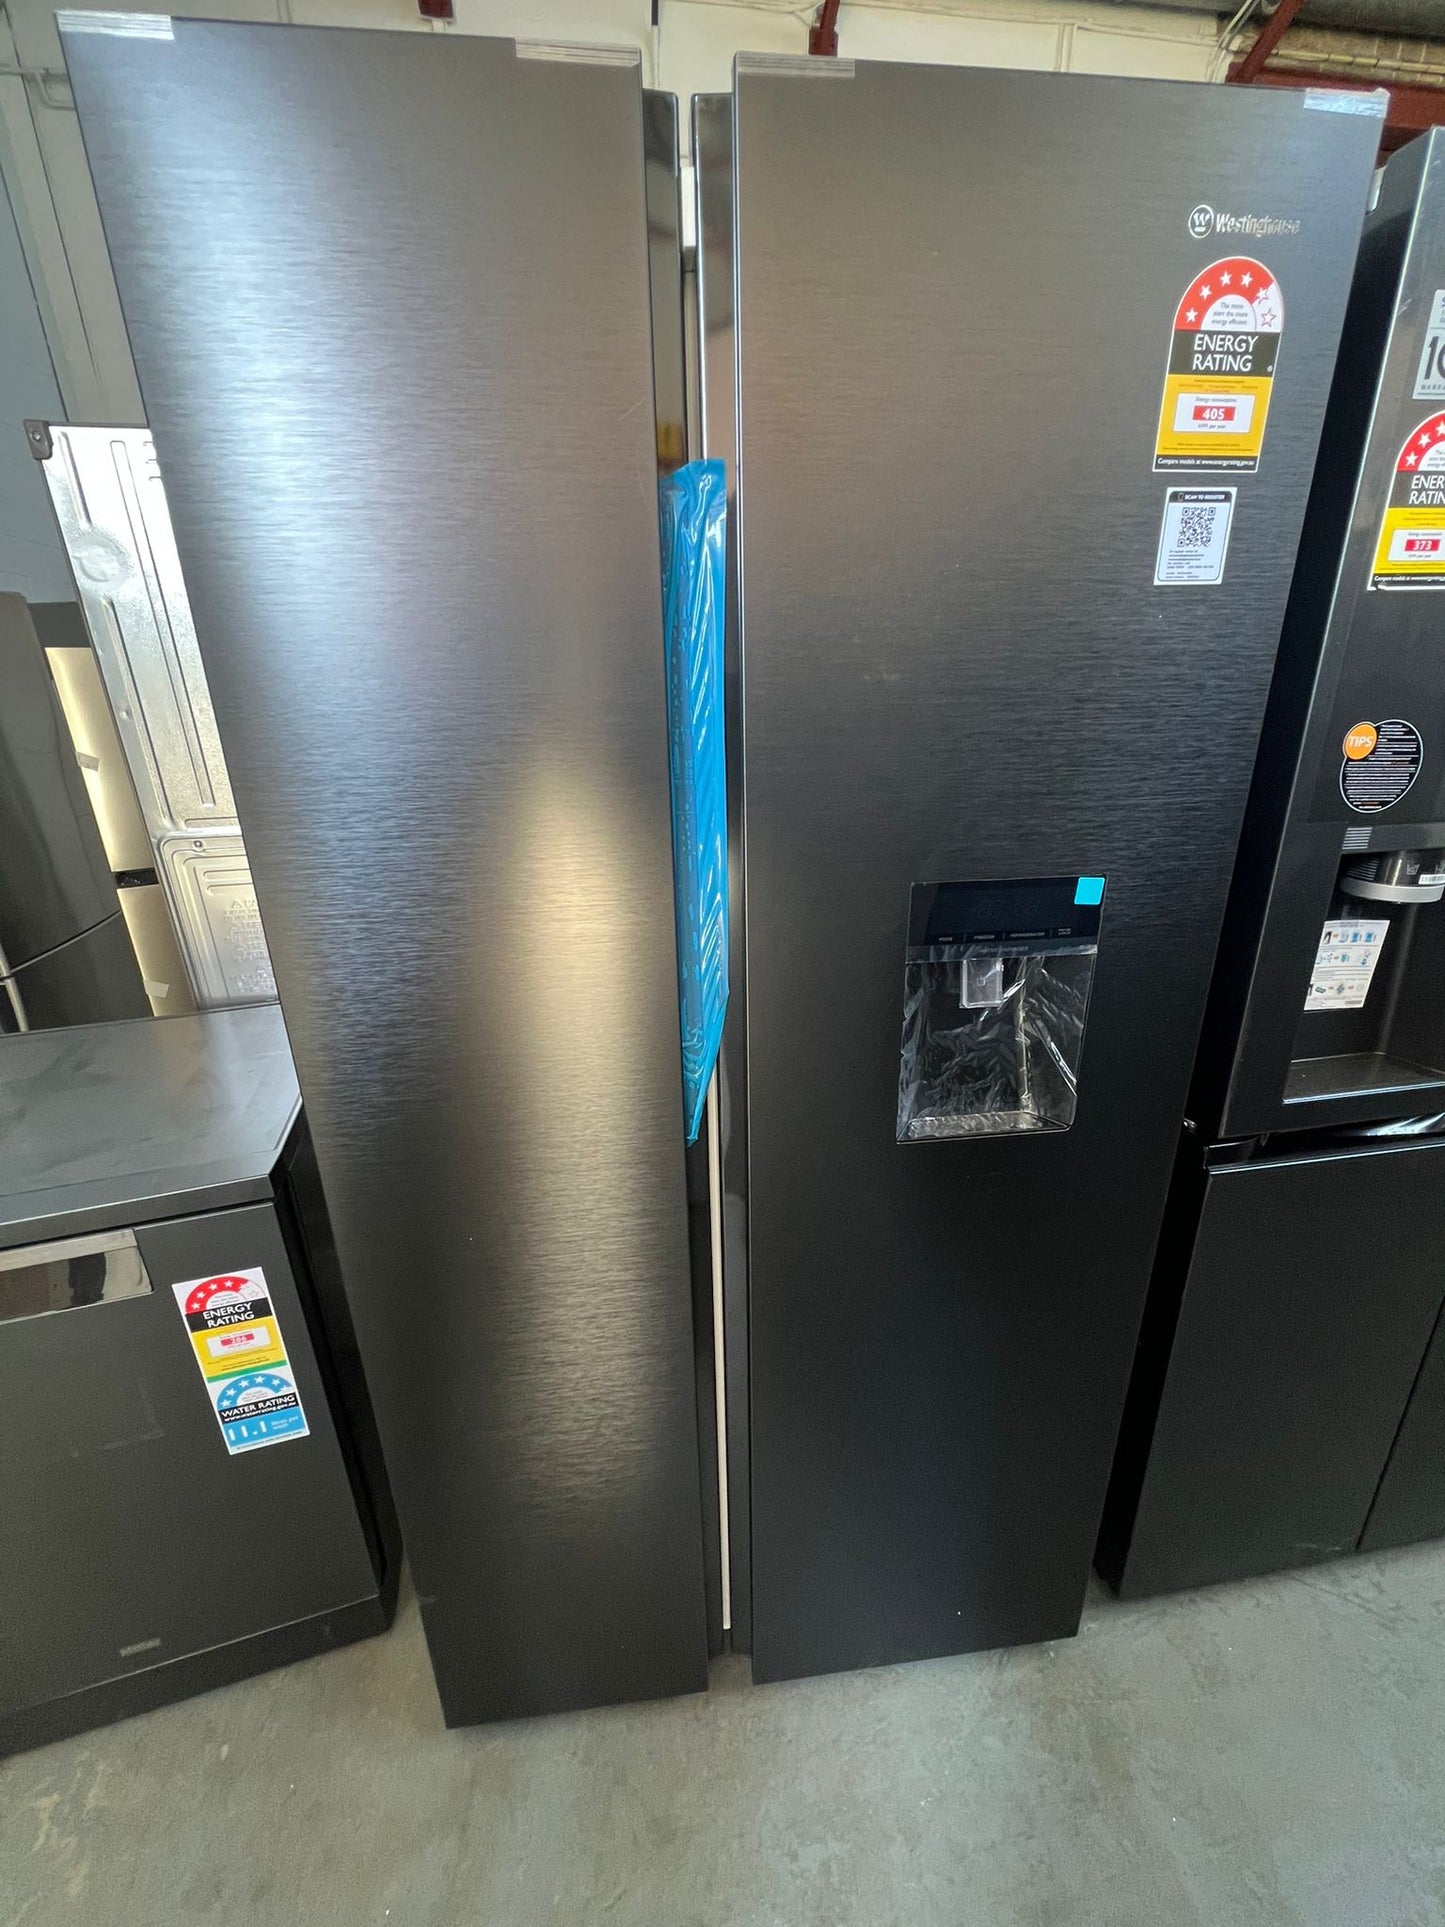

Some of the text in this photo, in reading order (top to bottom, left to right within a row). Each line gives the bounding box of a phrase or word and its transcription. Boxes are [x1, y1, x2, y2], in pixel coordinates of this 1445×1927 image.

[1215, 213, 1300, 237] Westinghouse
[1194, 333, 1258, 353] ENERGY
[1192, 353, 1253, 372] RATING
[1202, 407, 1226, 420] 405
[1413, 540, 1432, 551] 373
[1348, 735, 1374, 748] TIPS
[203, 1302, 252, 1320] ENERGY
[207, 1311, 255, 1328] RATING
[221, 1404, 256, 1417] WATER
[258, 1394, 295, 1409] RATING
